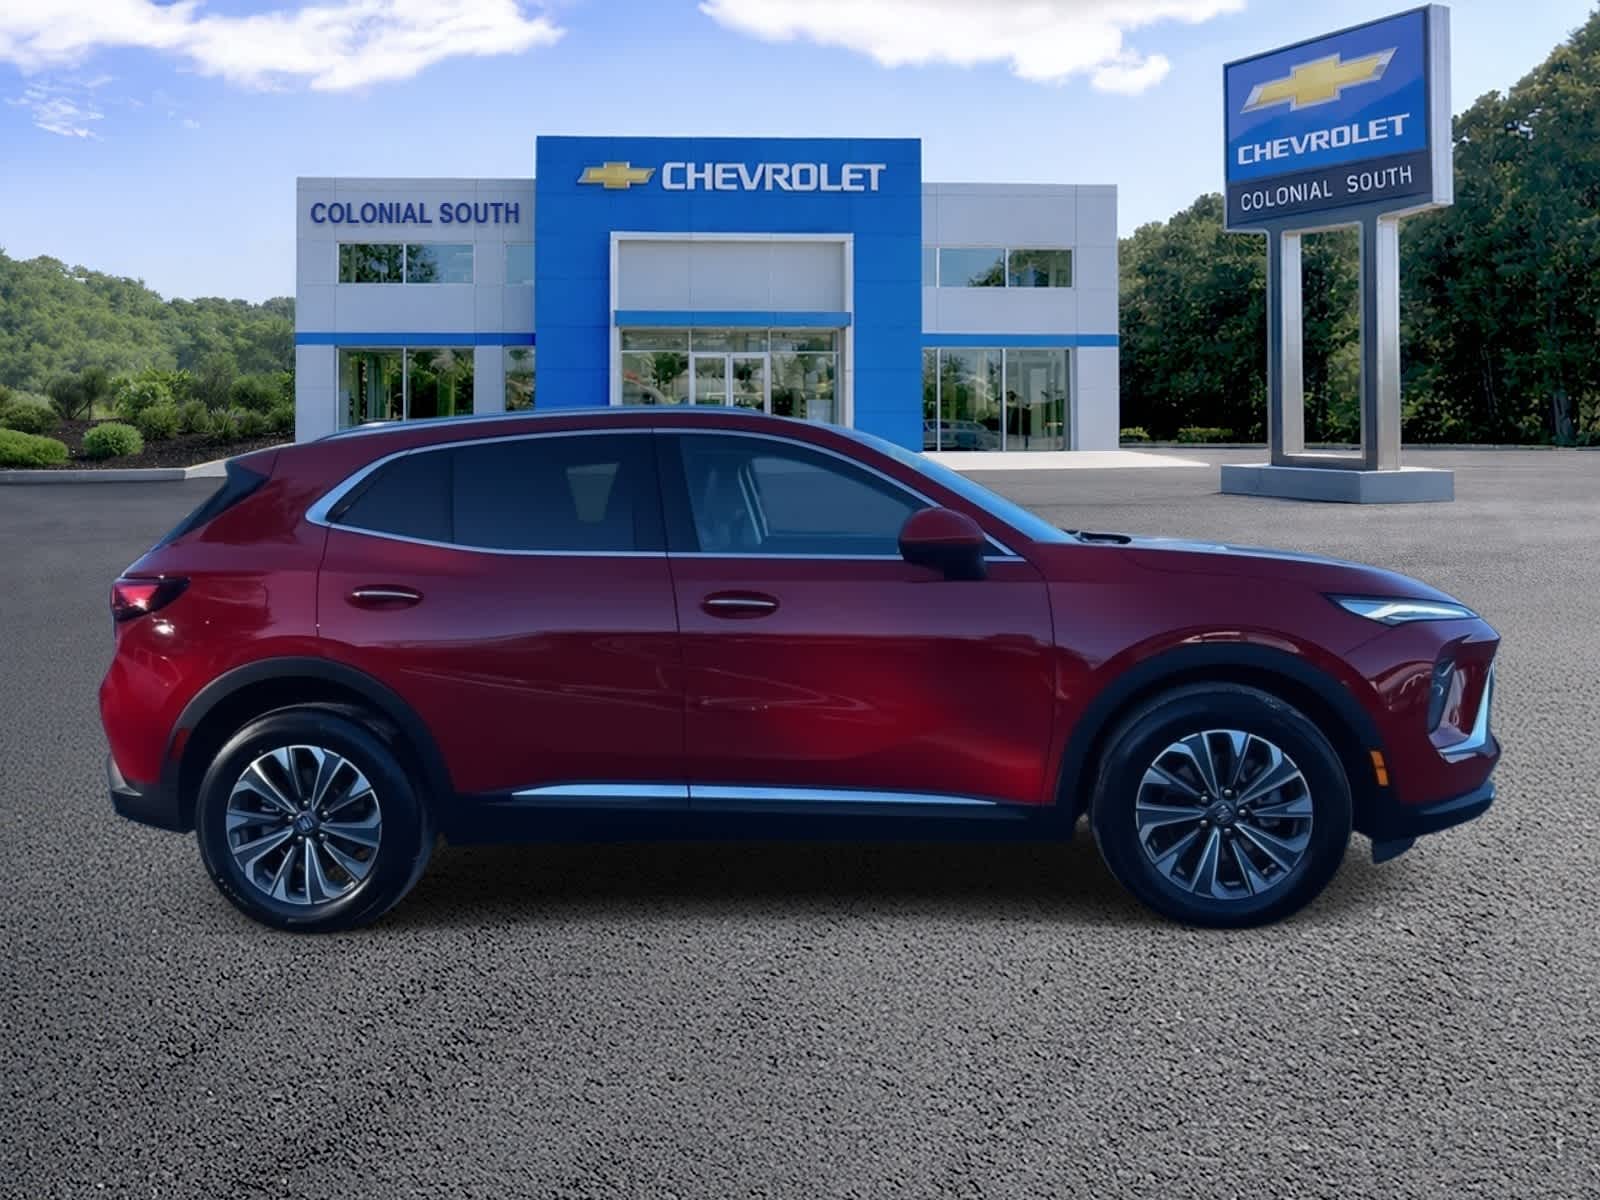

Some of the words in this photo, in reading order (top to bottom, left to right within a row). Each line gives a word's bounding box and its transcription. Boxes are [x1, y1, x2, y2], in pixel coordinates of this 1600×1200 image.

[1238, 113, 1410, 165] CHEVROLET
[661, 162, 886, 193] CHEVROLET
[1241, 180, 1333, 211] COLONIAL
[1347, 165, 1412, 194] SOUTH
[310, 202, 433, 225] COLONIAL
[439, 202, 520, 225] SOUTH
